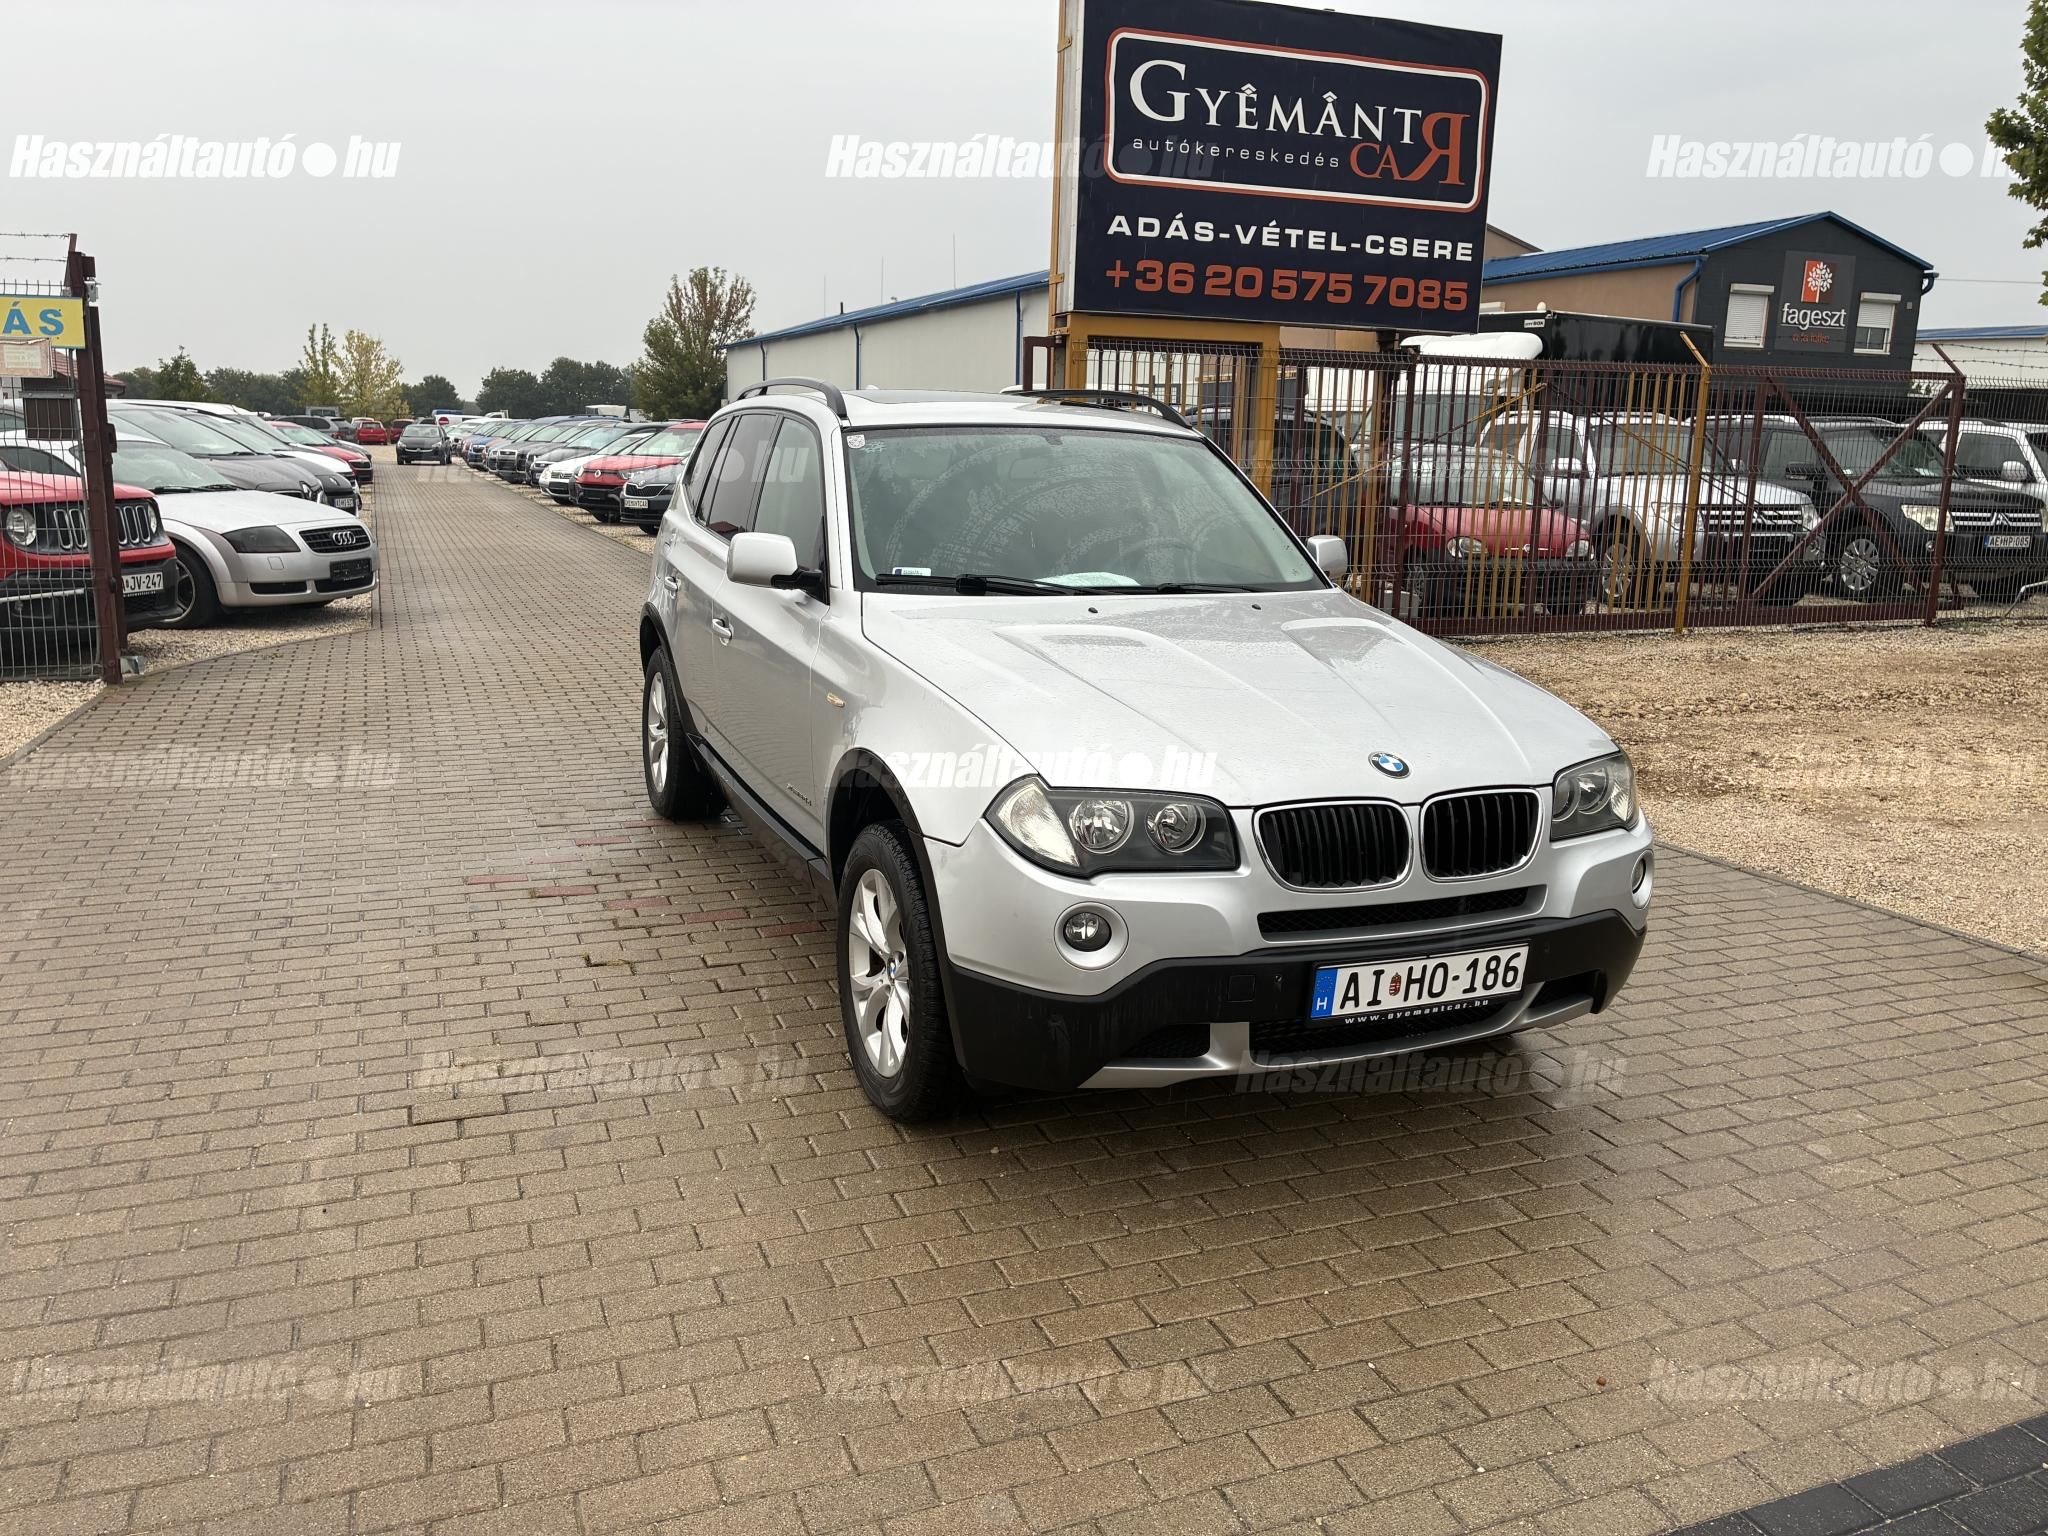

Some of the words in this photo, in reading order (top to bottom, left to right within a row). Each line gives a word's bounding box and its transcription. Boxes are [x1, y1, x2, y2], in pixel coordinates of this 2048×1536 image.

[1132, 138, 1340, 169] autókereskedés
[1107, 211, 1474, 262] ADÁS-VÉTEL-CSERE
[1105, 259, 1196, 296] +36
[1204, 264, 1264, 299] 20
[1271, 268, 1354, 305] 575
[1363, 274, 1469, 312] 7085
[1782, 302, 1847, 331] fageszt
